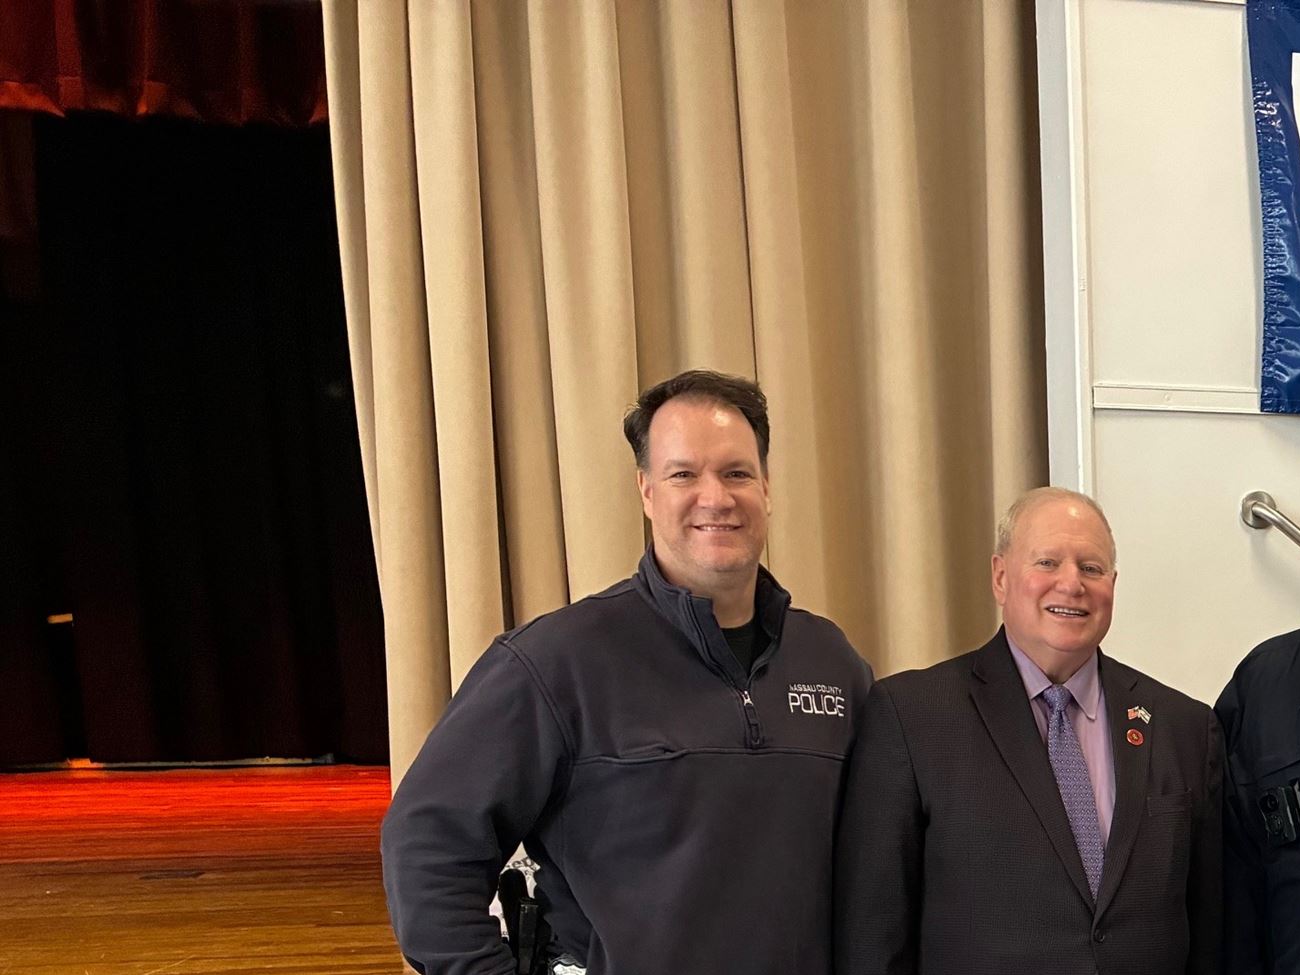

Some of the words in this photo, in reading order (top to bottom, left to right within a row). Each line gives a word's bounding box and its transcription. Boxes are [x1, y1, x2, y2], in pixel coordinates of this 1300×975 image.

[789, 684, 816, 692] NASSAU
[816, 684, 842, 695] COUNTY
[788, 692, 845, 717] POLICE
